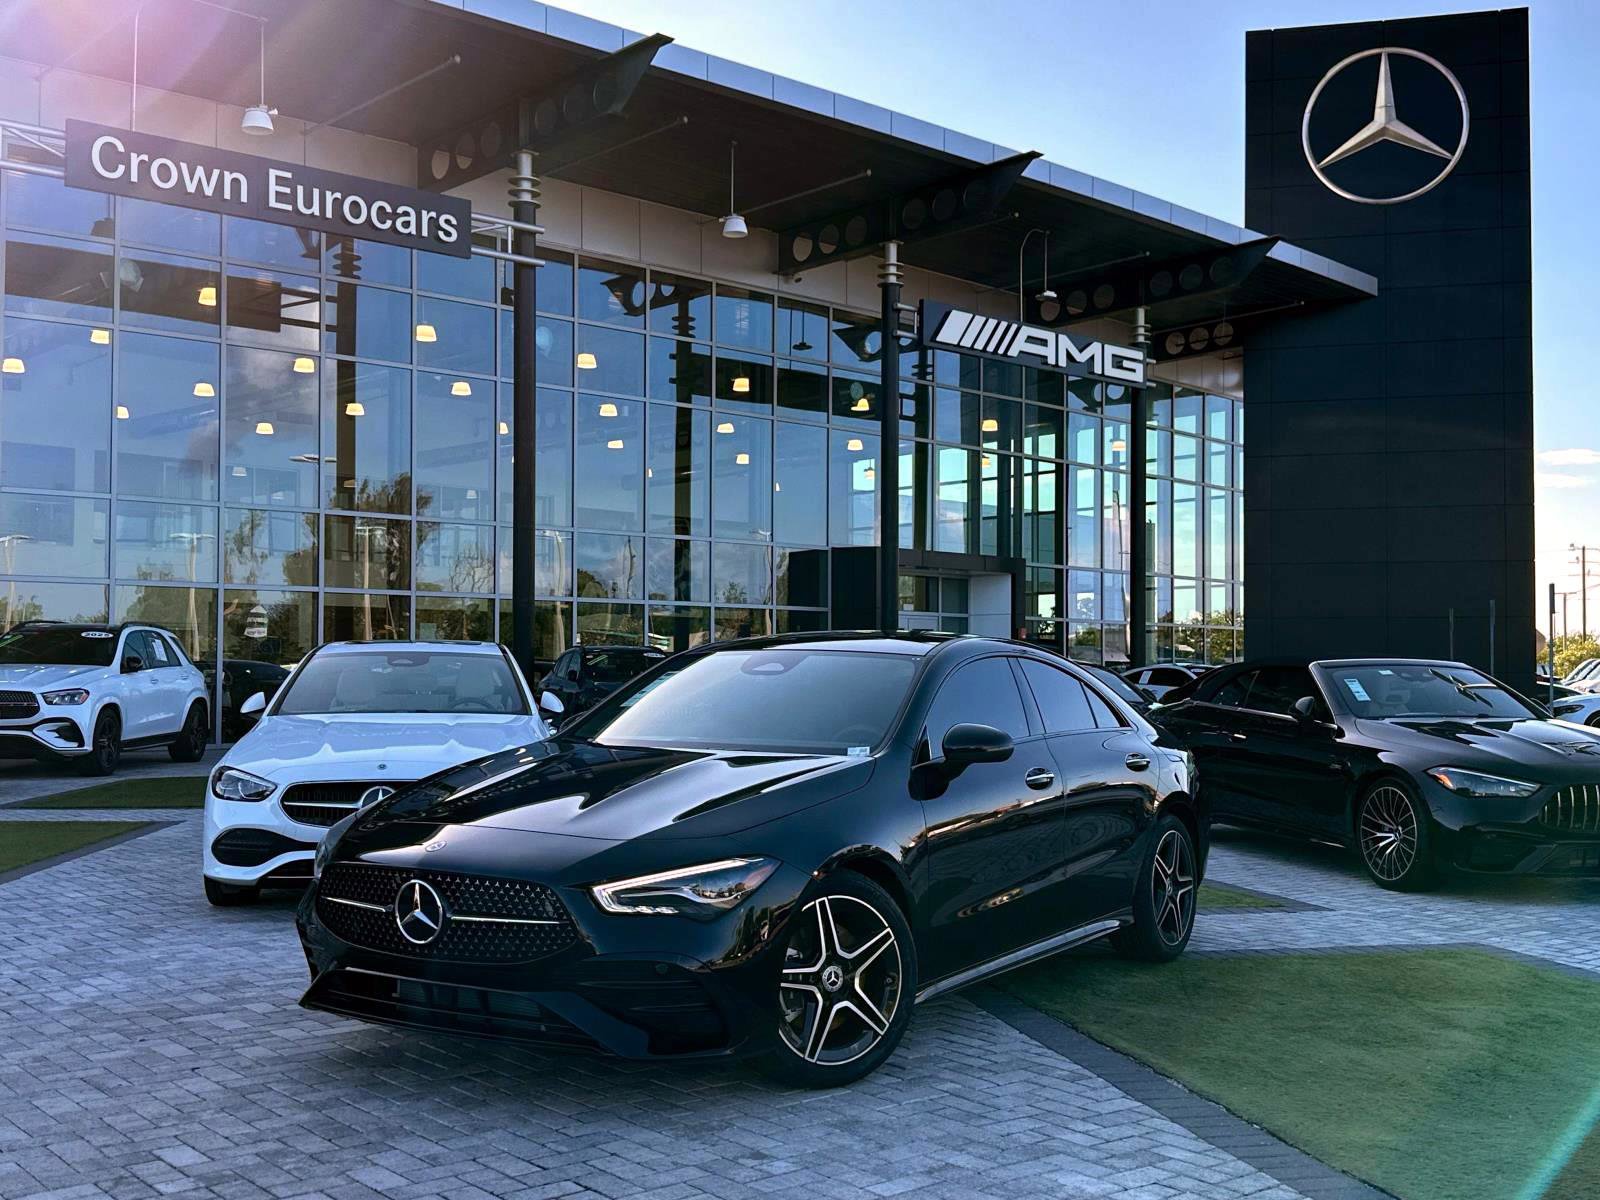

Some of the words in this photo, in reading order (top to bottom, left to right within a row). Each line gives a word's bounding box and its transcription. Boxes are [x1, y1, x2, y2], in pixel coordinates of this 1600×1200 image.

[91, 135, 248, 203] Crown
[268, 168, 458, 243] Eurocars
[1007, 324, 1144, 383] AMG
